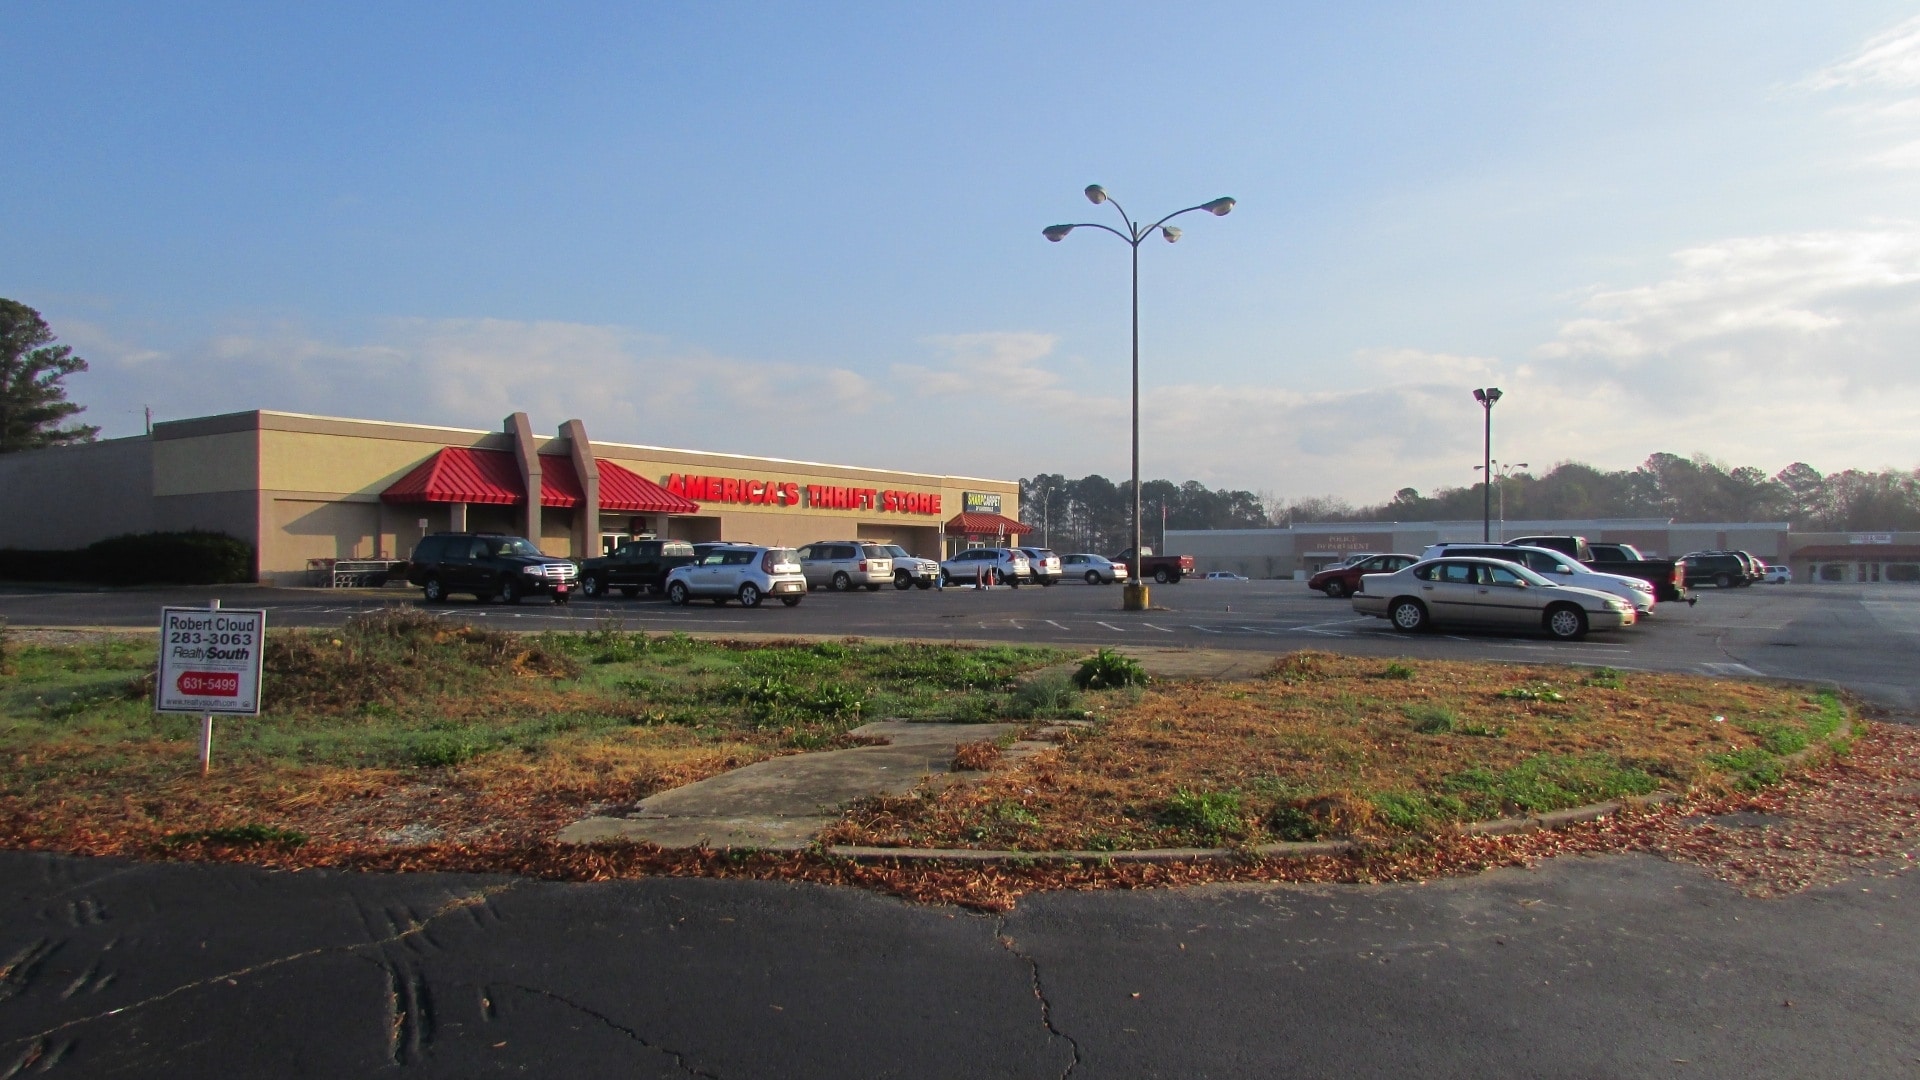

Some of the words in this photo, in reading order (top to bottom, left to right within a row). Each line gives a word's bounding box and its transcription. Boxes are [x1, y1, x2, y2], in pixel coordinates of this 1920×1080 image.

[666, 473, 800, 506] AMERICA'S
[807, 484, 877, 510] THRIFT
[883, 489, 942, 514] STORE
[1316, 542, 1369, 550] DEPARTMENT
[170, 616, 212, 630] Robert
[216, 617, 254, 631] Cloud
[170, 632, 252, 645] 283-3063
[172, 646, 250, 661] RealtySouth
[183, 677, 236, 691] 631-5499
